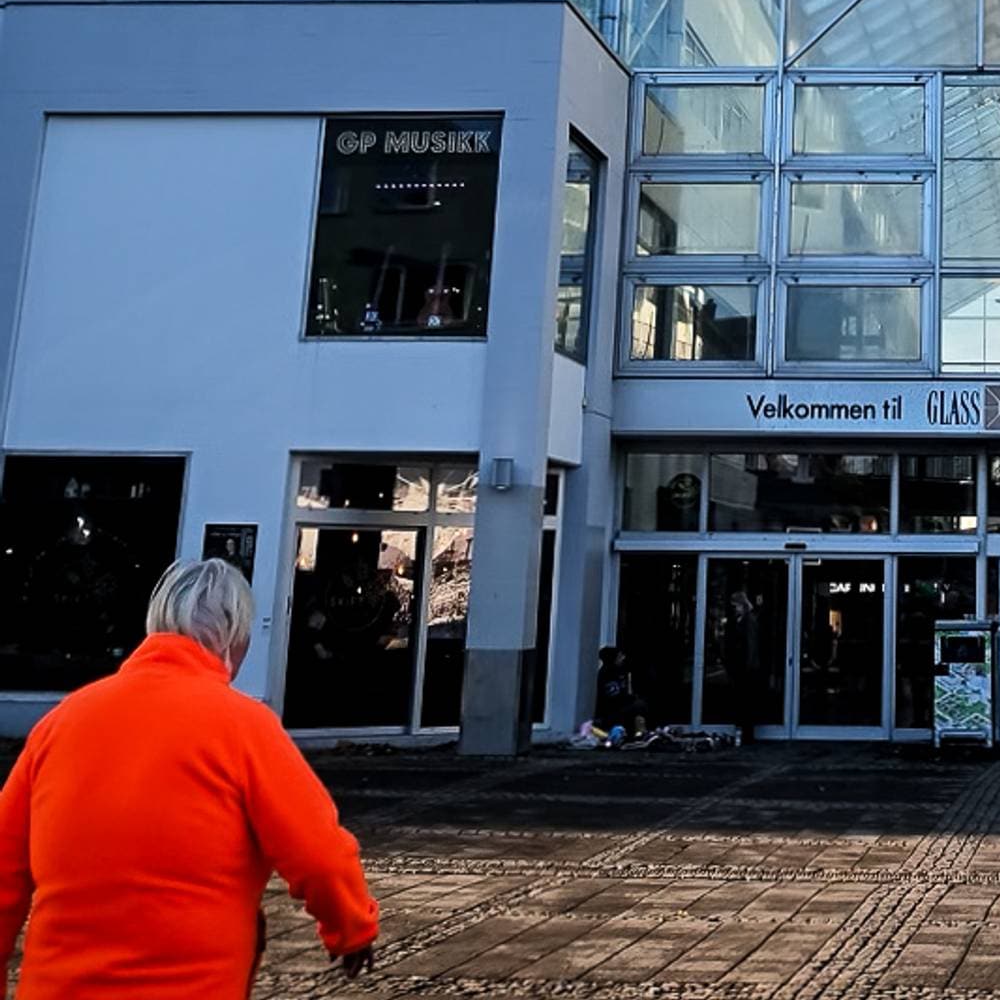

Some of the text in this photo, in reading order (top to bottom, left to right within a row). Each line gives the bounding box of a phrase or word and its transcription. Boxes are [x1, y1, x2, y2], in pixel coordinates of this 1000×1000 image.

[335, 130, 492, 156] GP MUSIKK
[745, 394, 876, 421] Velkommen
[882, 394, 903, 420] til
[926, 389, 981, 427] GLASS
